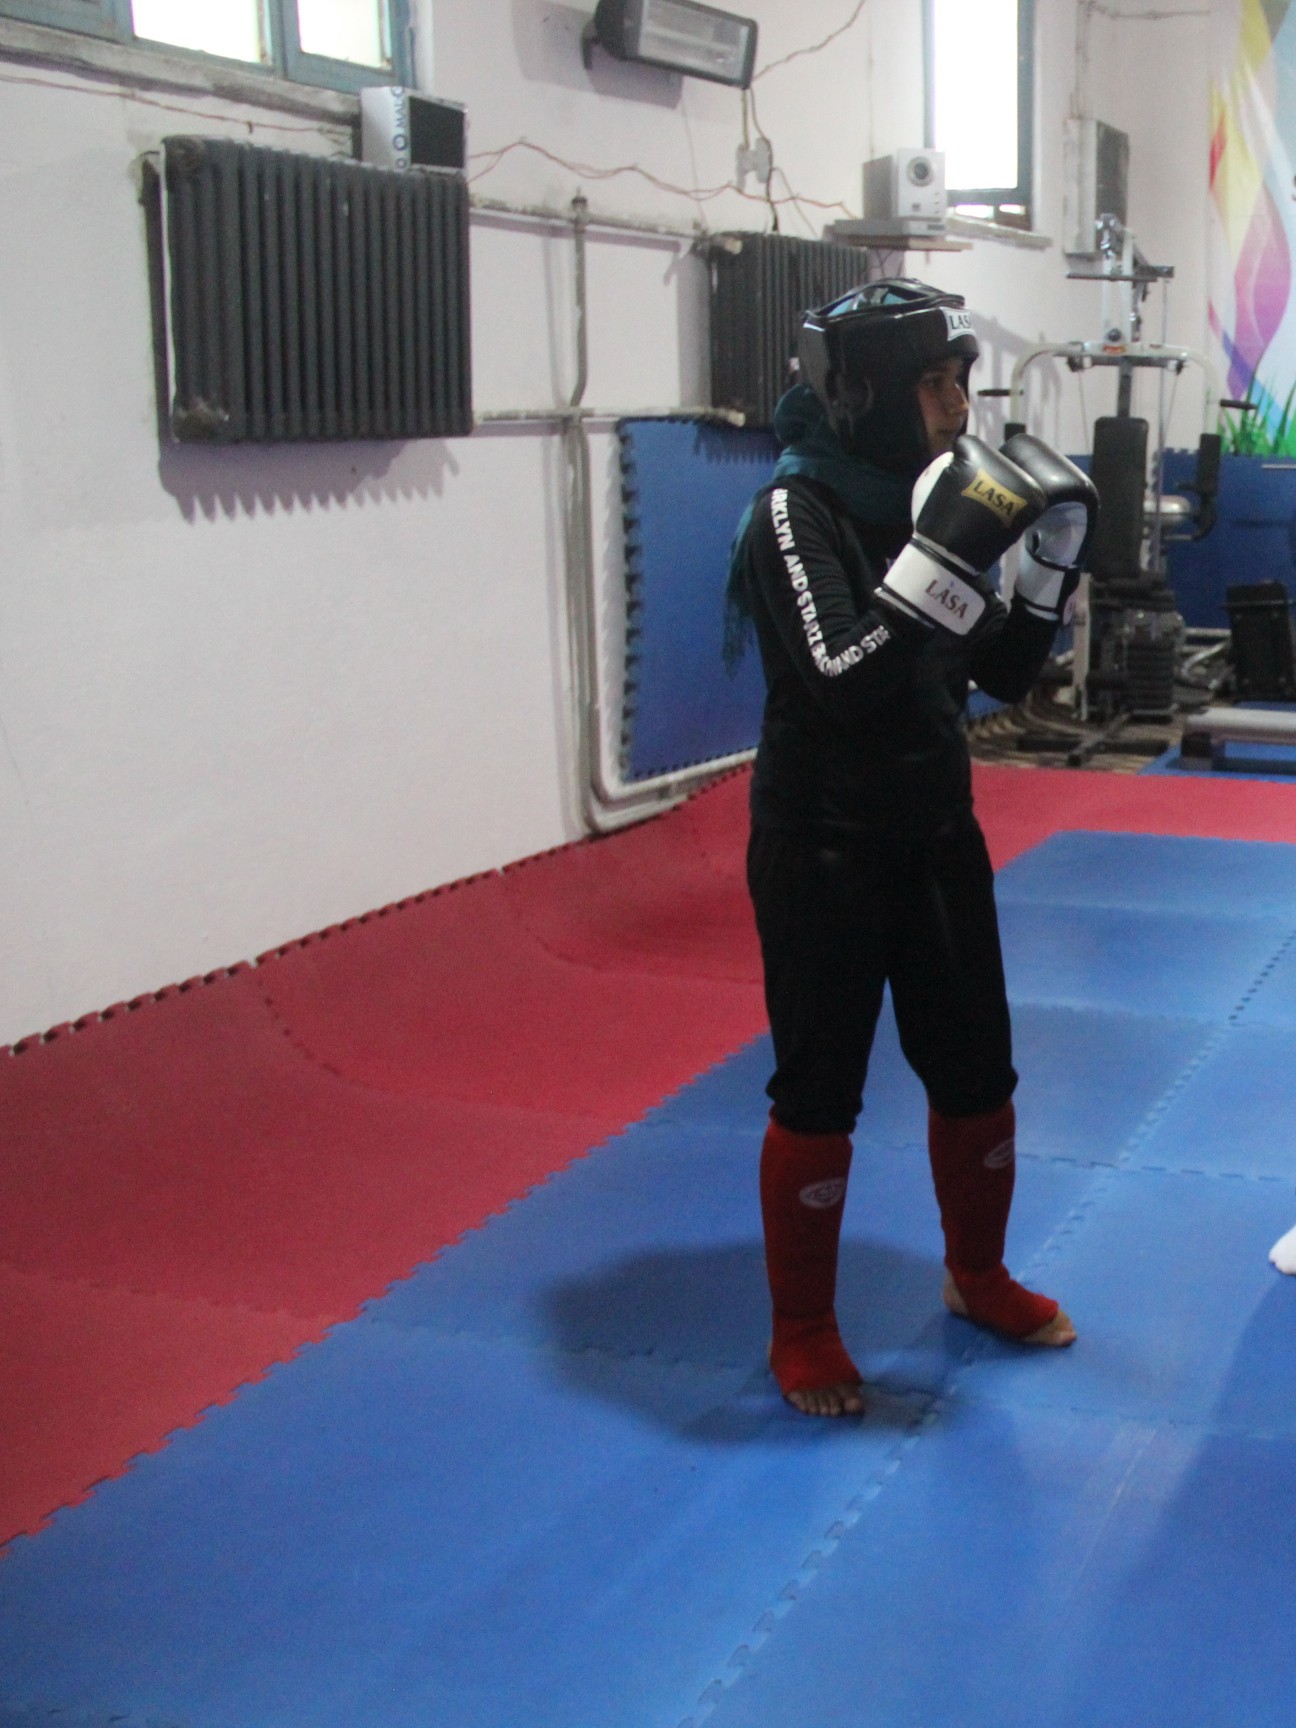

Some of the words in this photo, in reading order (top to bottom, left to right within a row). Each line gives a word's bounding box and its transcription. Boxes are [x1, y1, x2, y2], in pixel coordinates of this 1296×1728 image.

[948, 314, 972, 330] LAS
[973, 480, 1015, 516] LASA
[783, 554, 809, 592] AND
[925, 579, 969, 619] LASA
